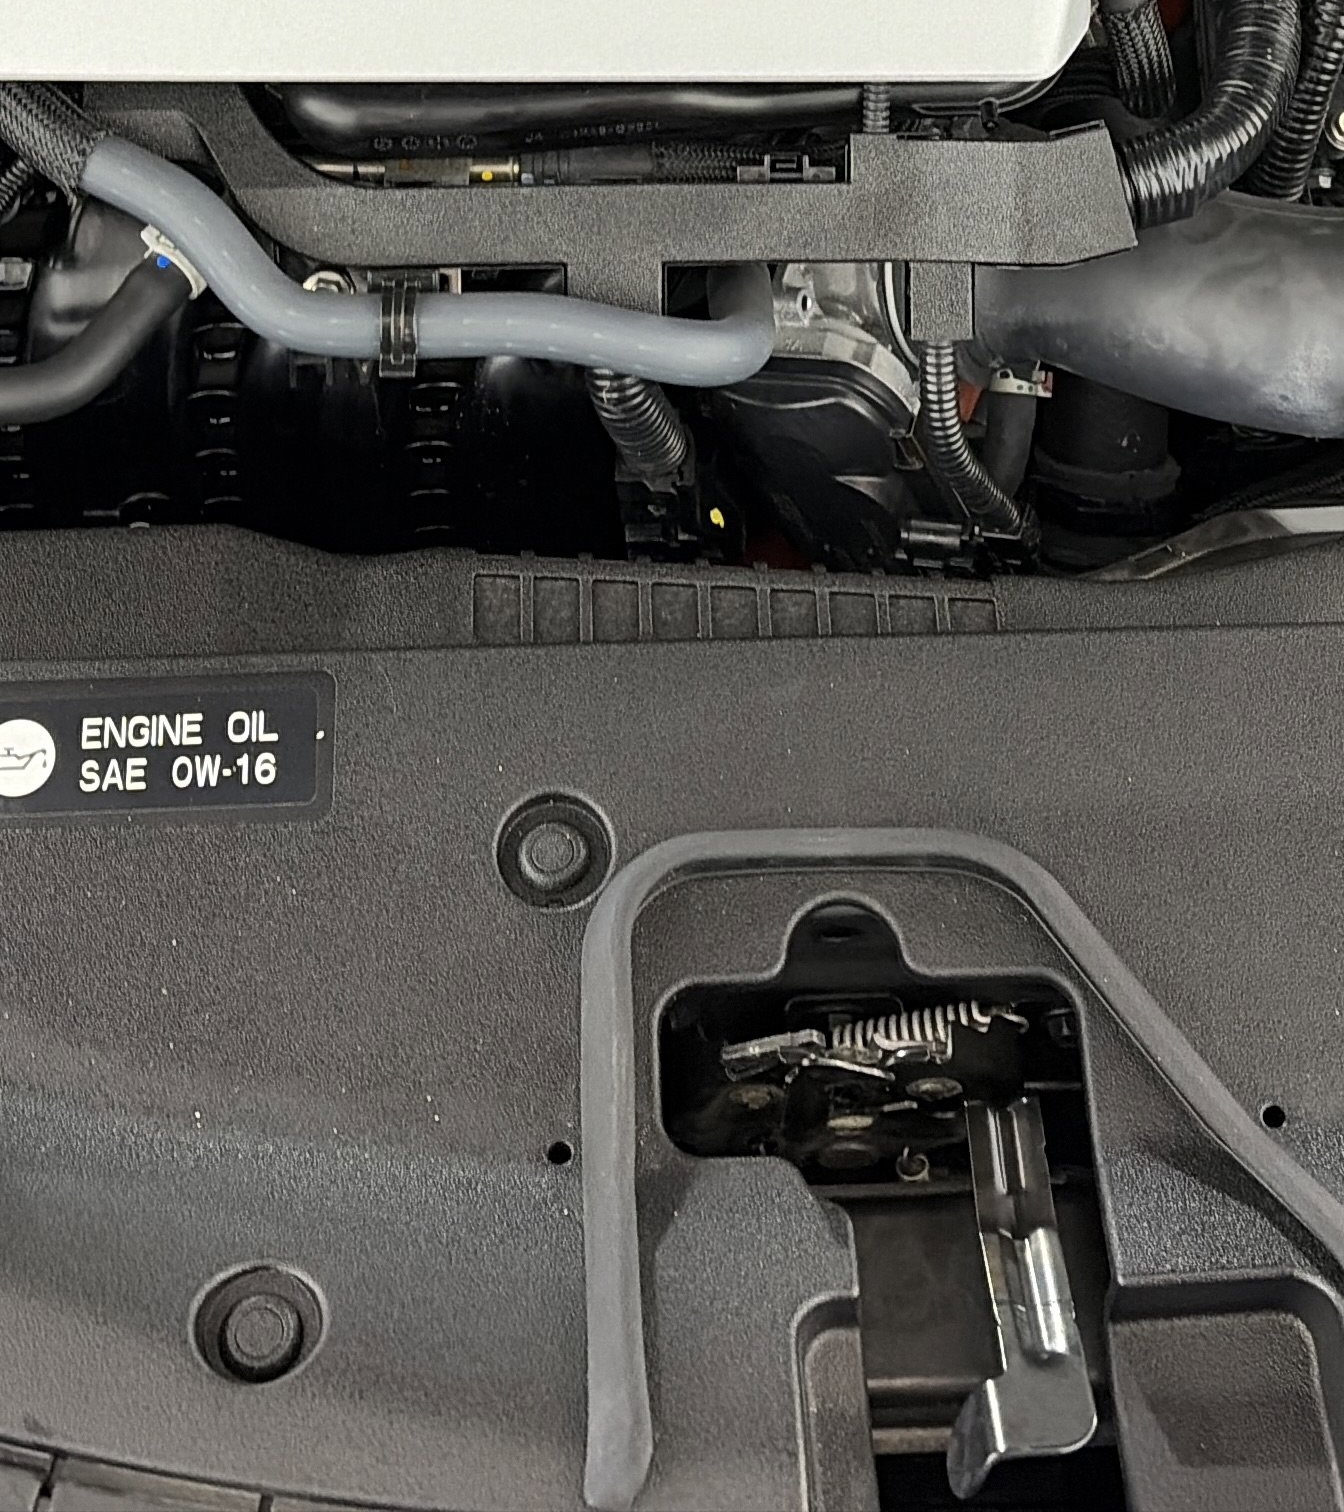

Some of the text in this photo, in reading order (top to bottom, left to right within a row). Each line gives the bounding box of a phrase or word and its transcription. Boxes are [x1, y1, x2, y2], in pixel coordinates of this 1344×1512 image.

[80, 709, 279, 750] ENGINE OIL
[79, 751, 277, 793] SAE 0W-16
